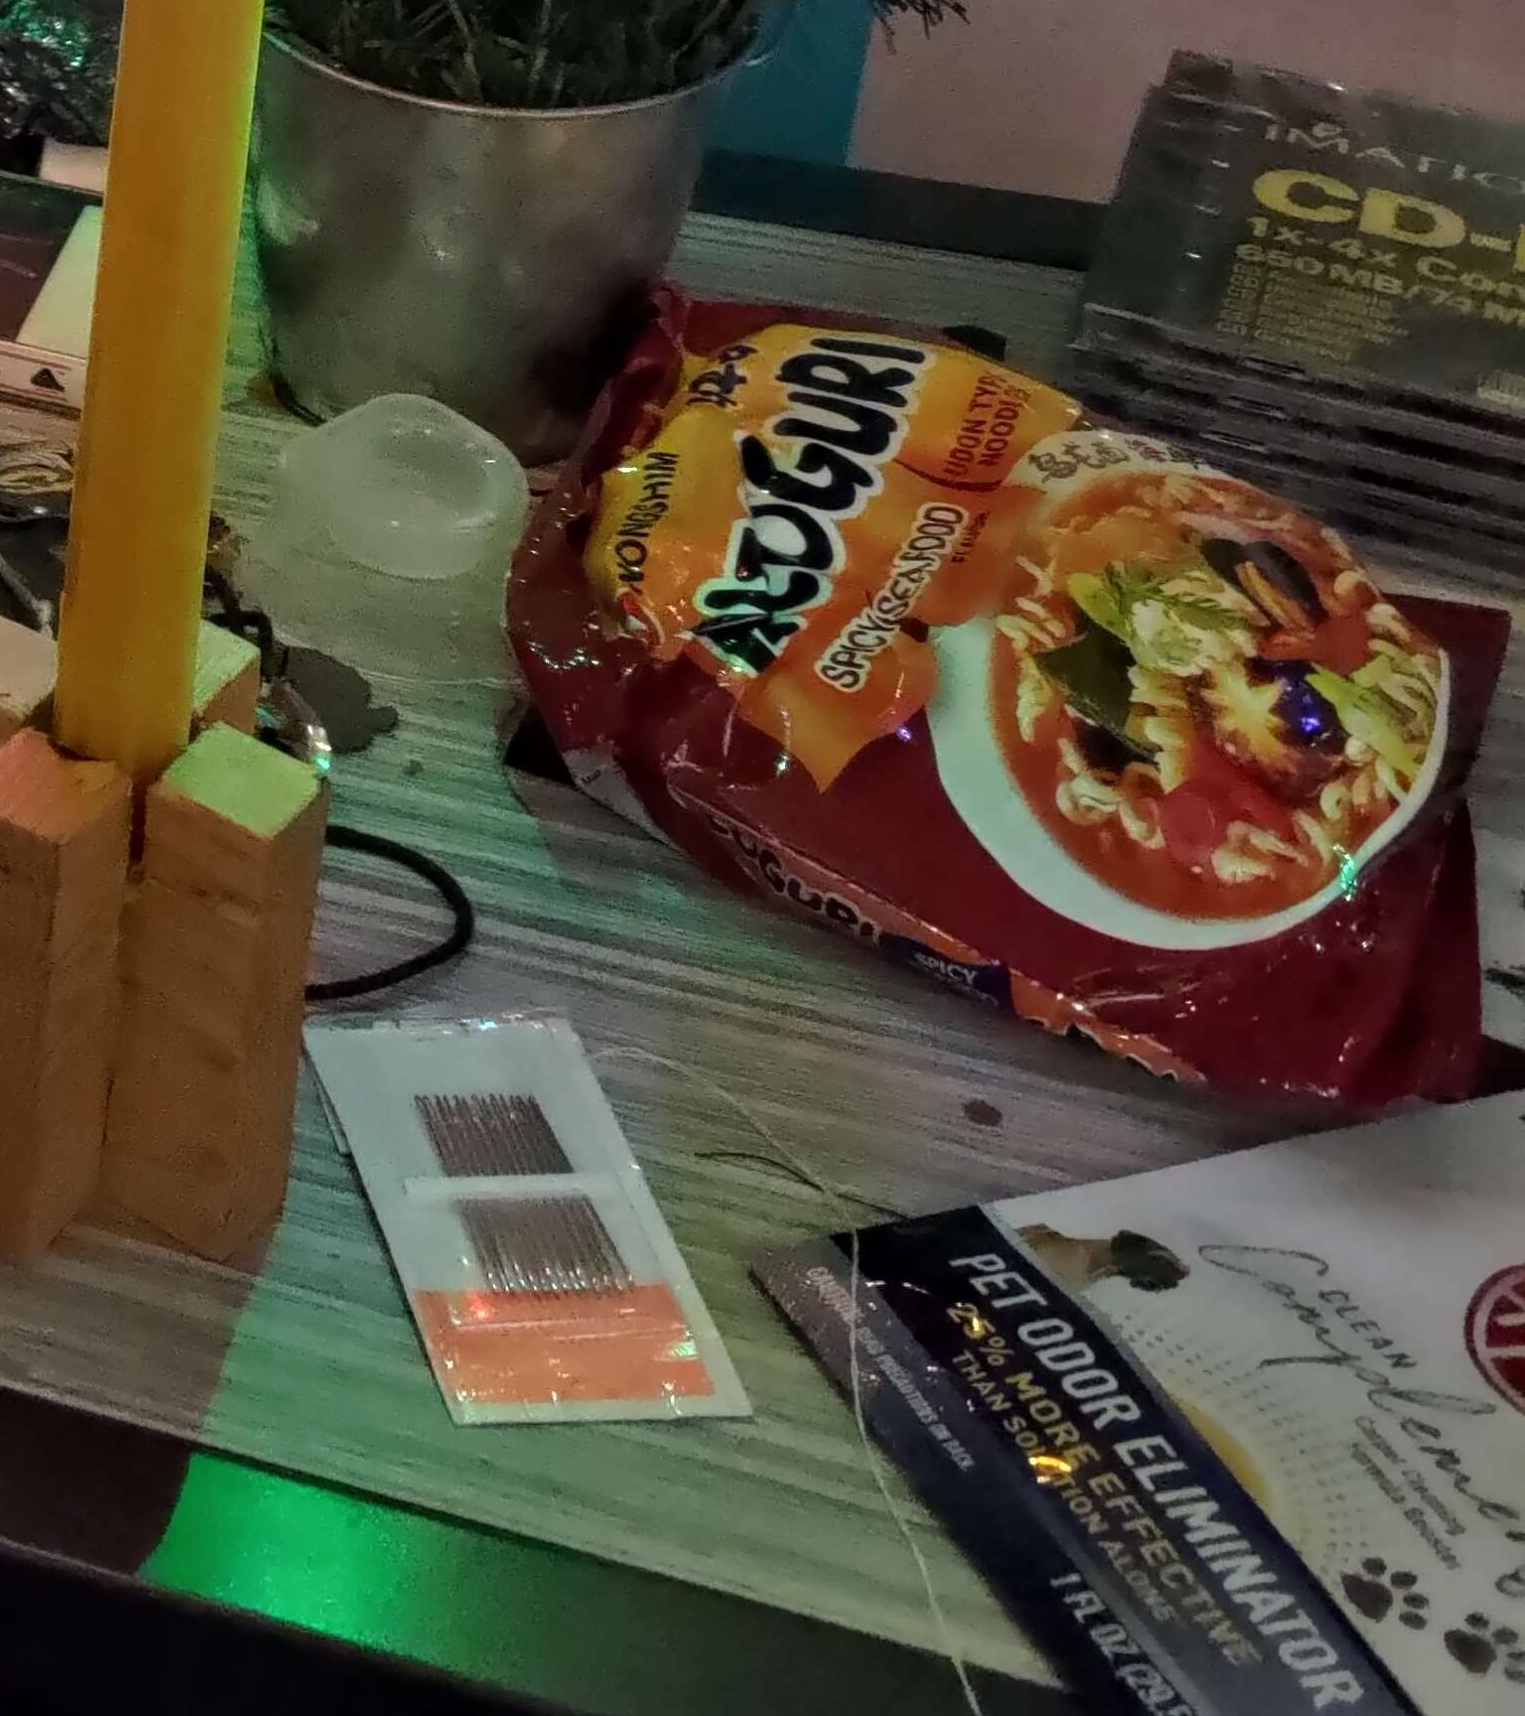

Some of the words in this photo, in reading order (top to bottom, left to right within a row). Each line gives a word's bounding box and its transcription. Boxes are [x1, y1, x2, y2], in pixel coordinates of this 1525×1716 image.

[1252, 168, 1525, 273] CD-
[944, 418, 985, 478] UDON
[821, 612, 897, 689] SPICY
[876, 506, 964, 617] SEAFOOD
[1318, 1289, 1417, 1369] CLEAN
[946, 1302, 1015, 1367] 25%
[1003, 1371, 1102, 1473] MORE
[1087, 1471, 1265, 1669] EFFECTIVE
[949, 1252, 1048, 1308] PET
[1017, 1317, 1142, 1430] ODOR
[1113, 1434, 1365, 1711] ELIMINATOR
[952, 1349, 1012, 1412] THAN
[1002, 1415, 1110, 1535] SOLTION
[1098, 1538, 1181, 1623] ALONE
[1090, 1623, 1140, 1662] OZ
